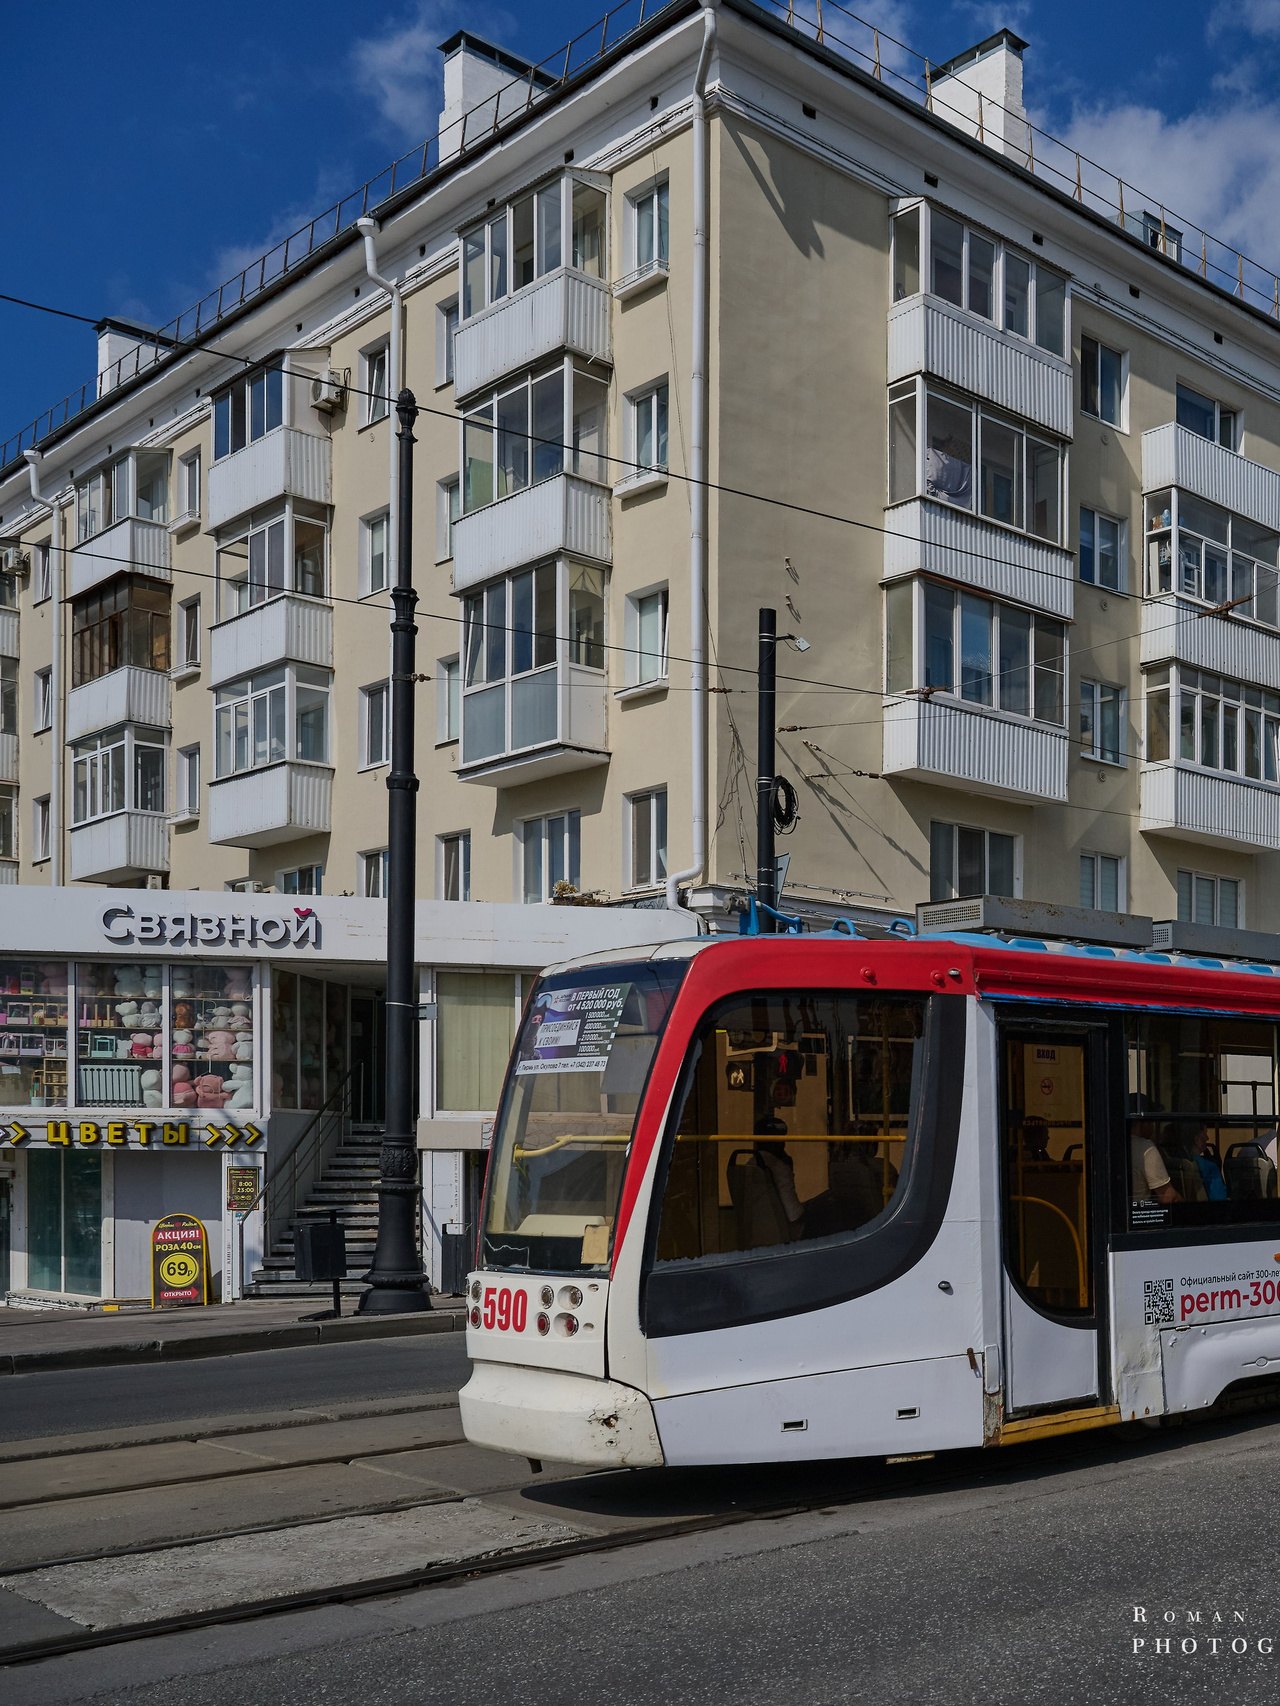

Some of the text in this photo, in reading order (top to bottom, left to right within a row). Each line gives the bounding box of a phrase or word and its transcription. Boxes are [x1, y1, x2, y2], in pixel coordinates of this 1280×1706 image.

[102, 903, 317, 945] Связной
[571, 992, 577, 1002] В
[576, 988, 604, 1001] ПЕРВЫЙ
[603, 988, 621, 999] ГОД
[581, 1001, 595, 1010] 520
[594, 1000, 607, 1009] 000
[605, 998, 624, 1011] руб.
[1037, 1049, 1055, 1061] ВХОД
[47, 1120, 190, 1147] ЦВЕТЫ
[157, 1230, 199, 1240] АКЦИЯ!
[155, 1243, 179, 1251] РОЗА
[1180, 1273, 1236, 1288] Официальный
[1238, 1271, 1254, 1281] сайт
[483, 1287, 528, 1333] 590
